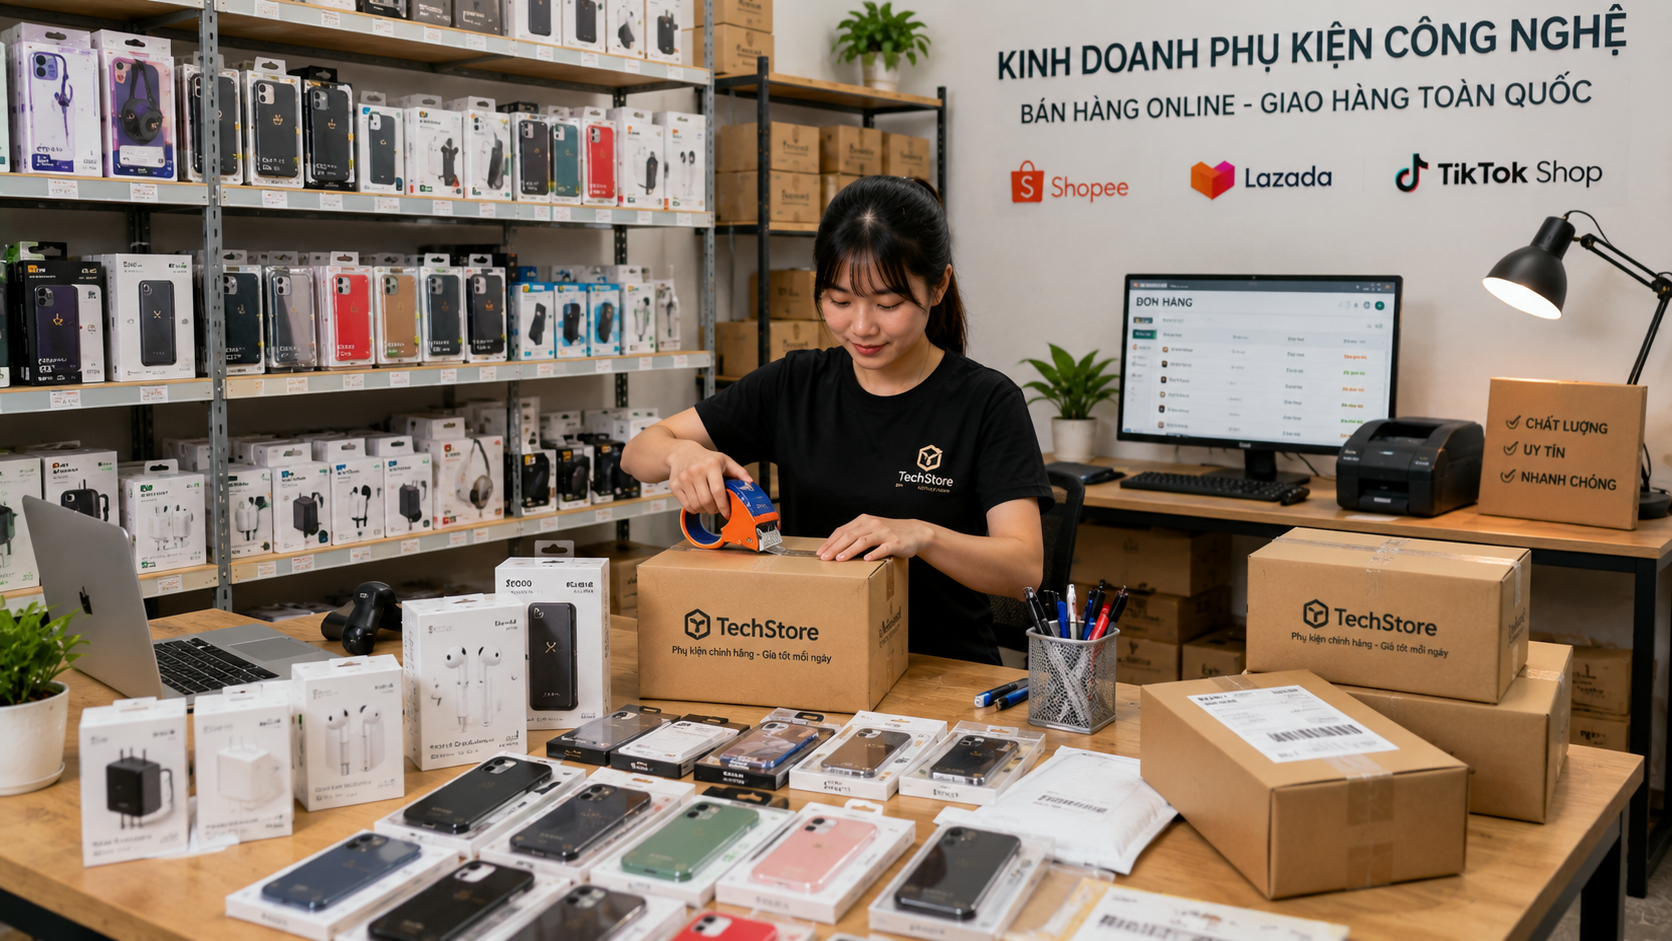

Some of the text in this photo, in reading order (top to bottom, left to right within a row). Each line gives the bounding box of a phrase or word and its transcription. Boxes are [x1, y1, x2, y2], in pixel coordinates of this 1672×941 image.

[998, 3, 1627, 80] KINH DOANH PHỤ KIỆN CÔNG NGHỆ
[1021, 97, 1066, 123] BÁN
[1073, 95, 1139, 122] HÀNG
[1146, 94, 1235, 118] ONLINE
[1260, 90, 1323, 114] GIAO
[1332, 83, 1410, 111] HÀNG
[1418, 79, 1495, 108] TOÀN
[1504, 71, 1592, 108] QUỐC
[1245, 165, 1332, 188] Lazada
[1437, 160, 1603, 188] TikTok Shop
[1051, 176, 1129, 203] Shopee
[1525, 415, 1560, 431] CHẤT
[1523, 444, 1541, 456] UY
[898, 471, 953, 487] TechStore
[1521, 471, 1617, 491] NHANH CHÓNG
[716, 617, 819, 641] TechStore
[1334, 608, 1437, 636] TechStore
